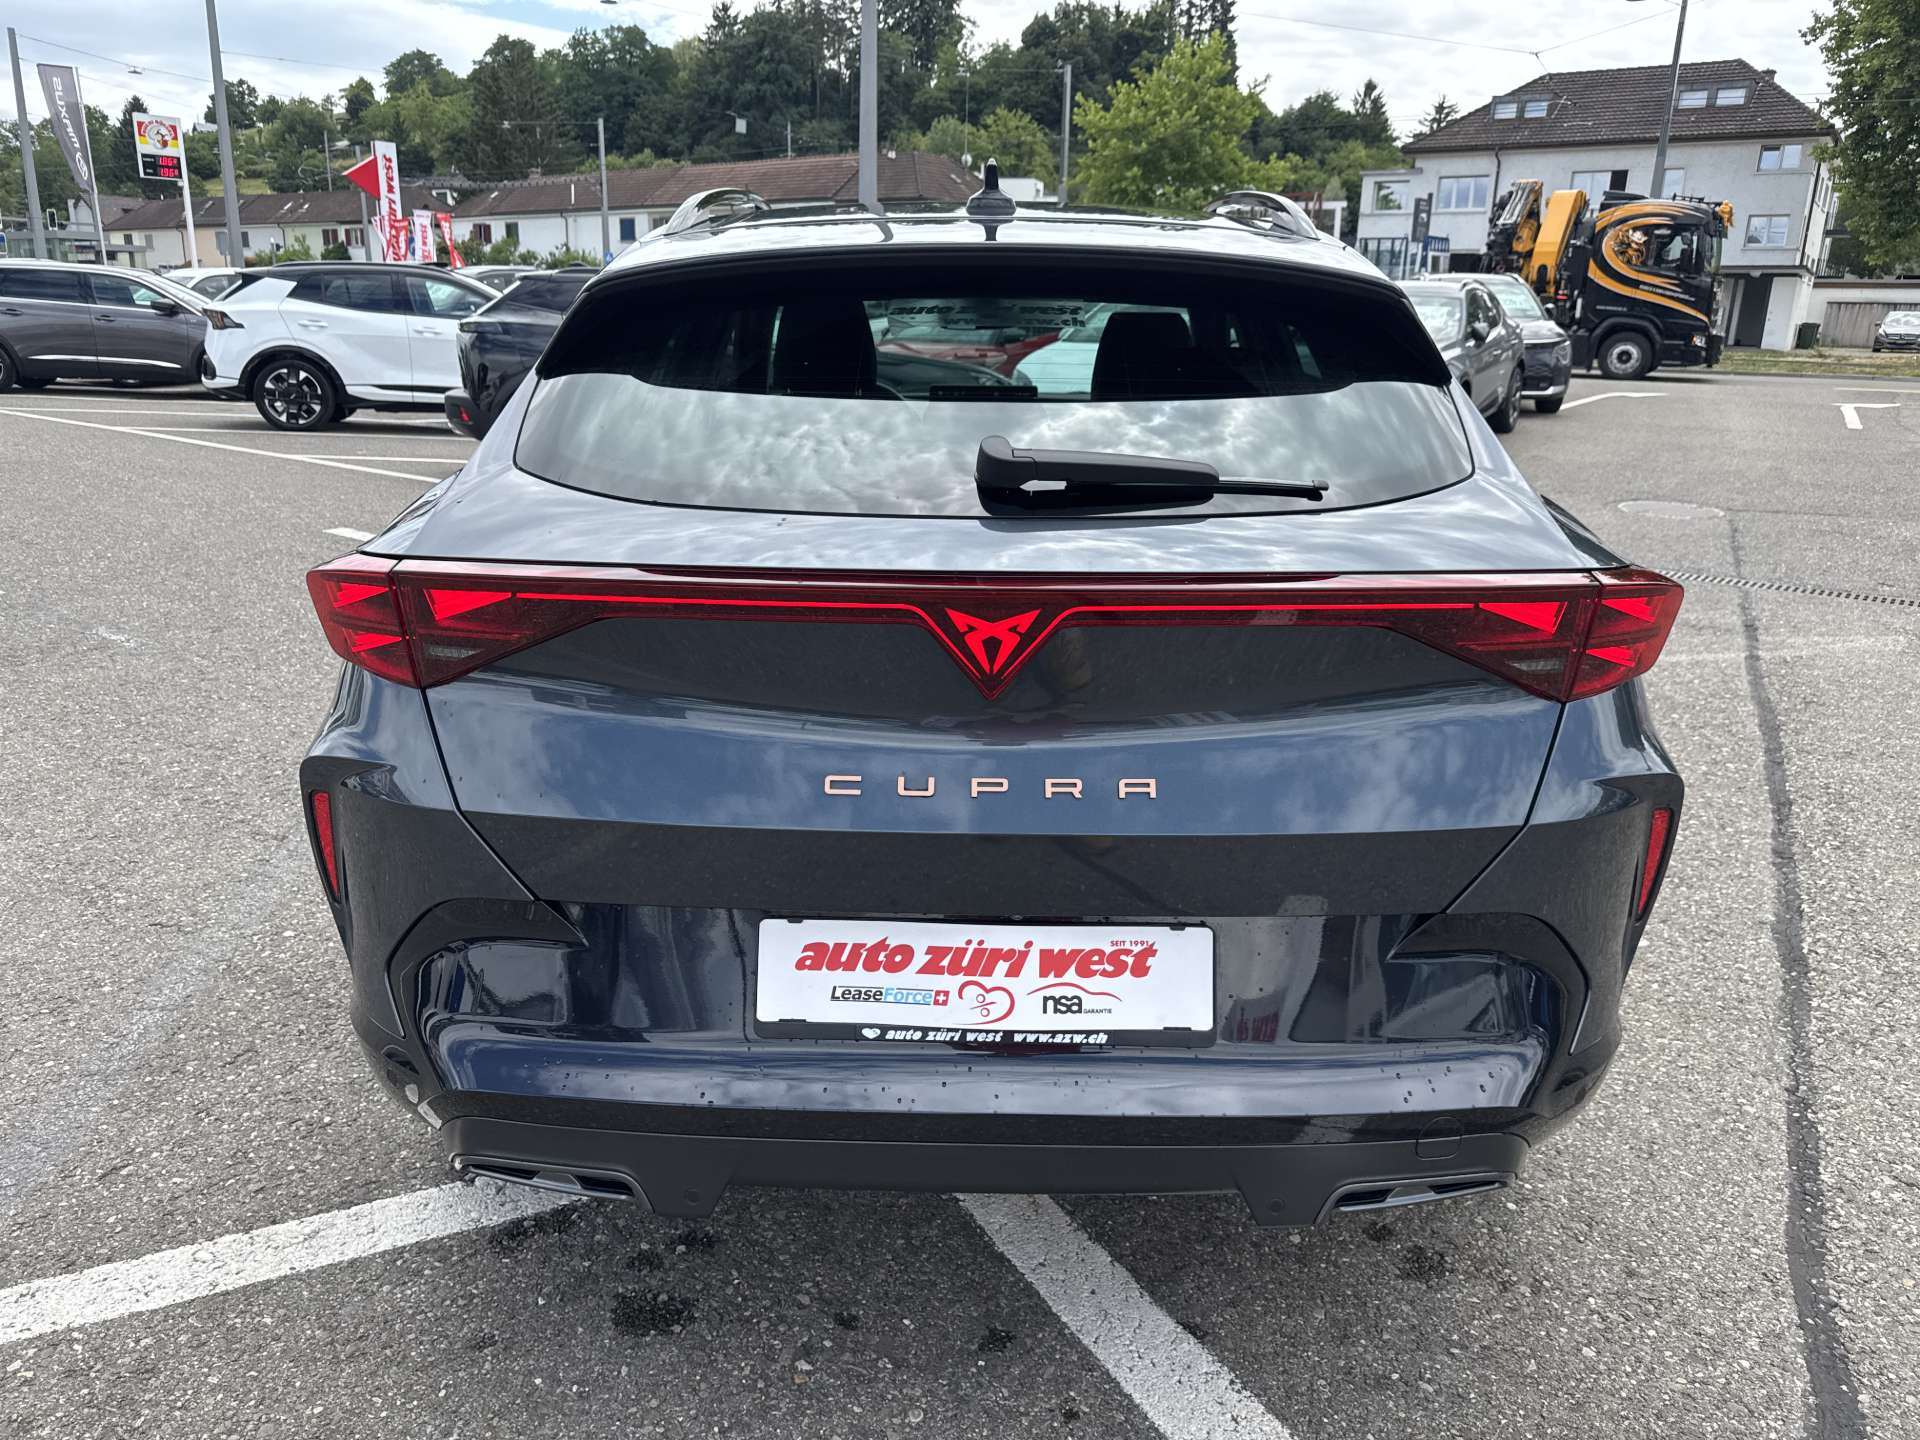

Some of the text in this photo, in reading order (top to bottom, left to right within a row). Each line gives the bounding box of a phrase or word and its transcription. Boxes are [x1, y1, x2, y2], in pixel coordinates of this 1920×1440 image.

[824, 775, 1157, 799] CUPRA
[1129, 940, 1149, 948] 1991
[795, 936, 1158, 978] auto züri west
[831, 985, 933, 1004] LeaseForce
[1042, 994, 1113, 1015] nsa GARANTIE
[885, 1028, 1108, 1044] auto züri west www.azw.ch
